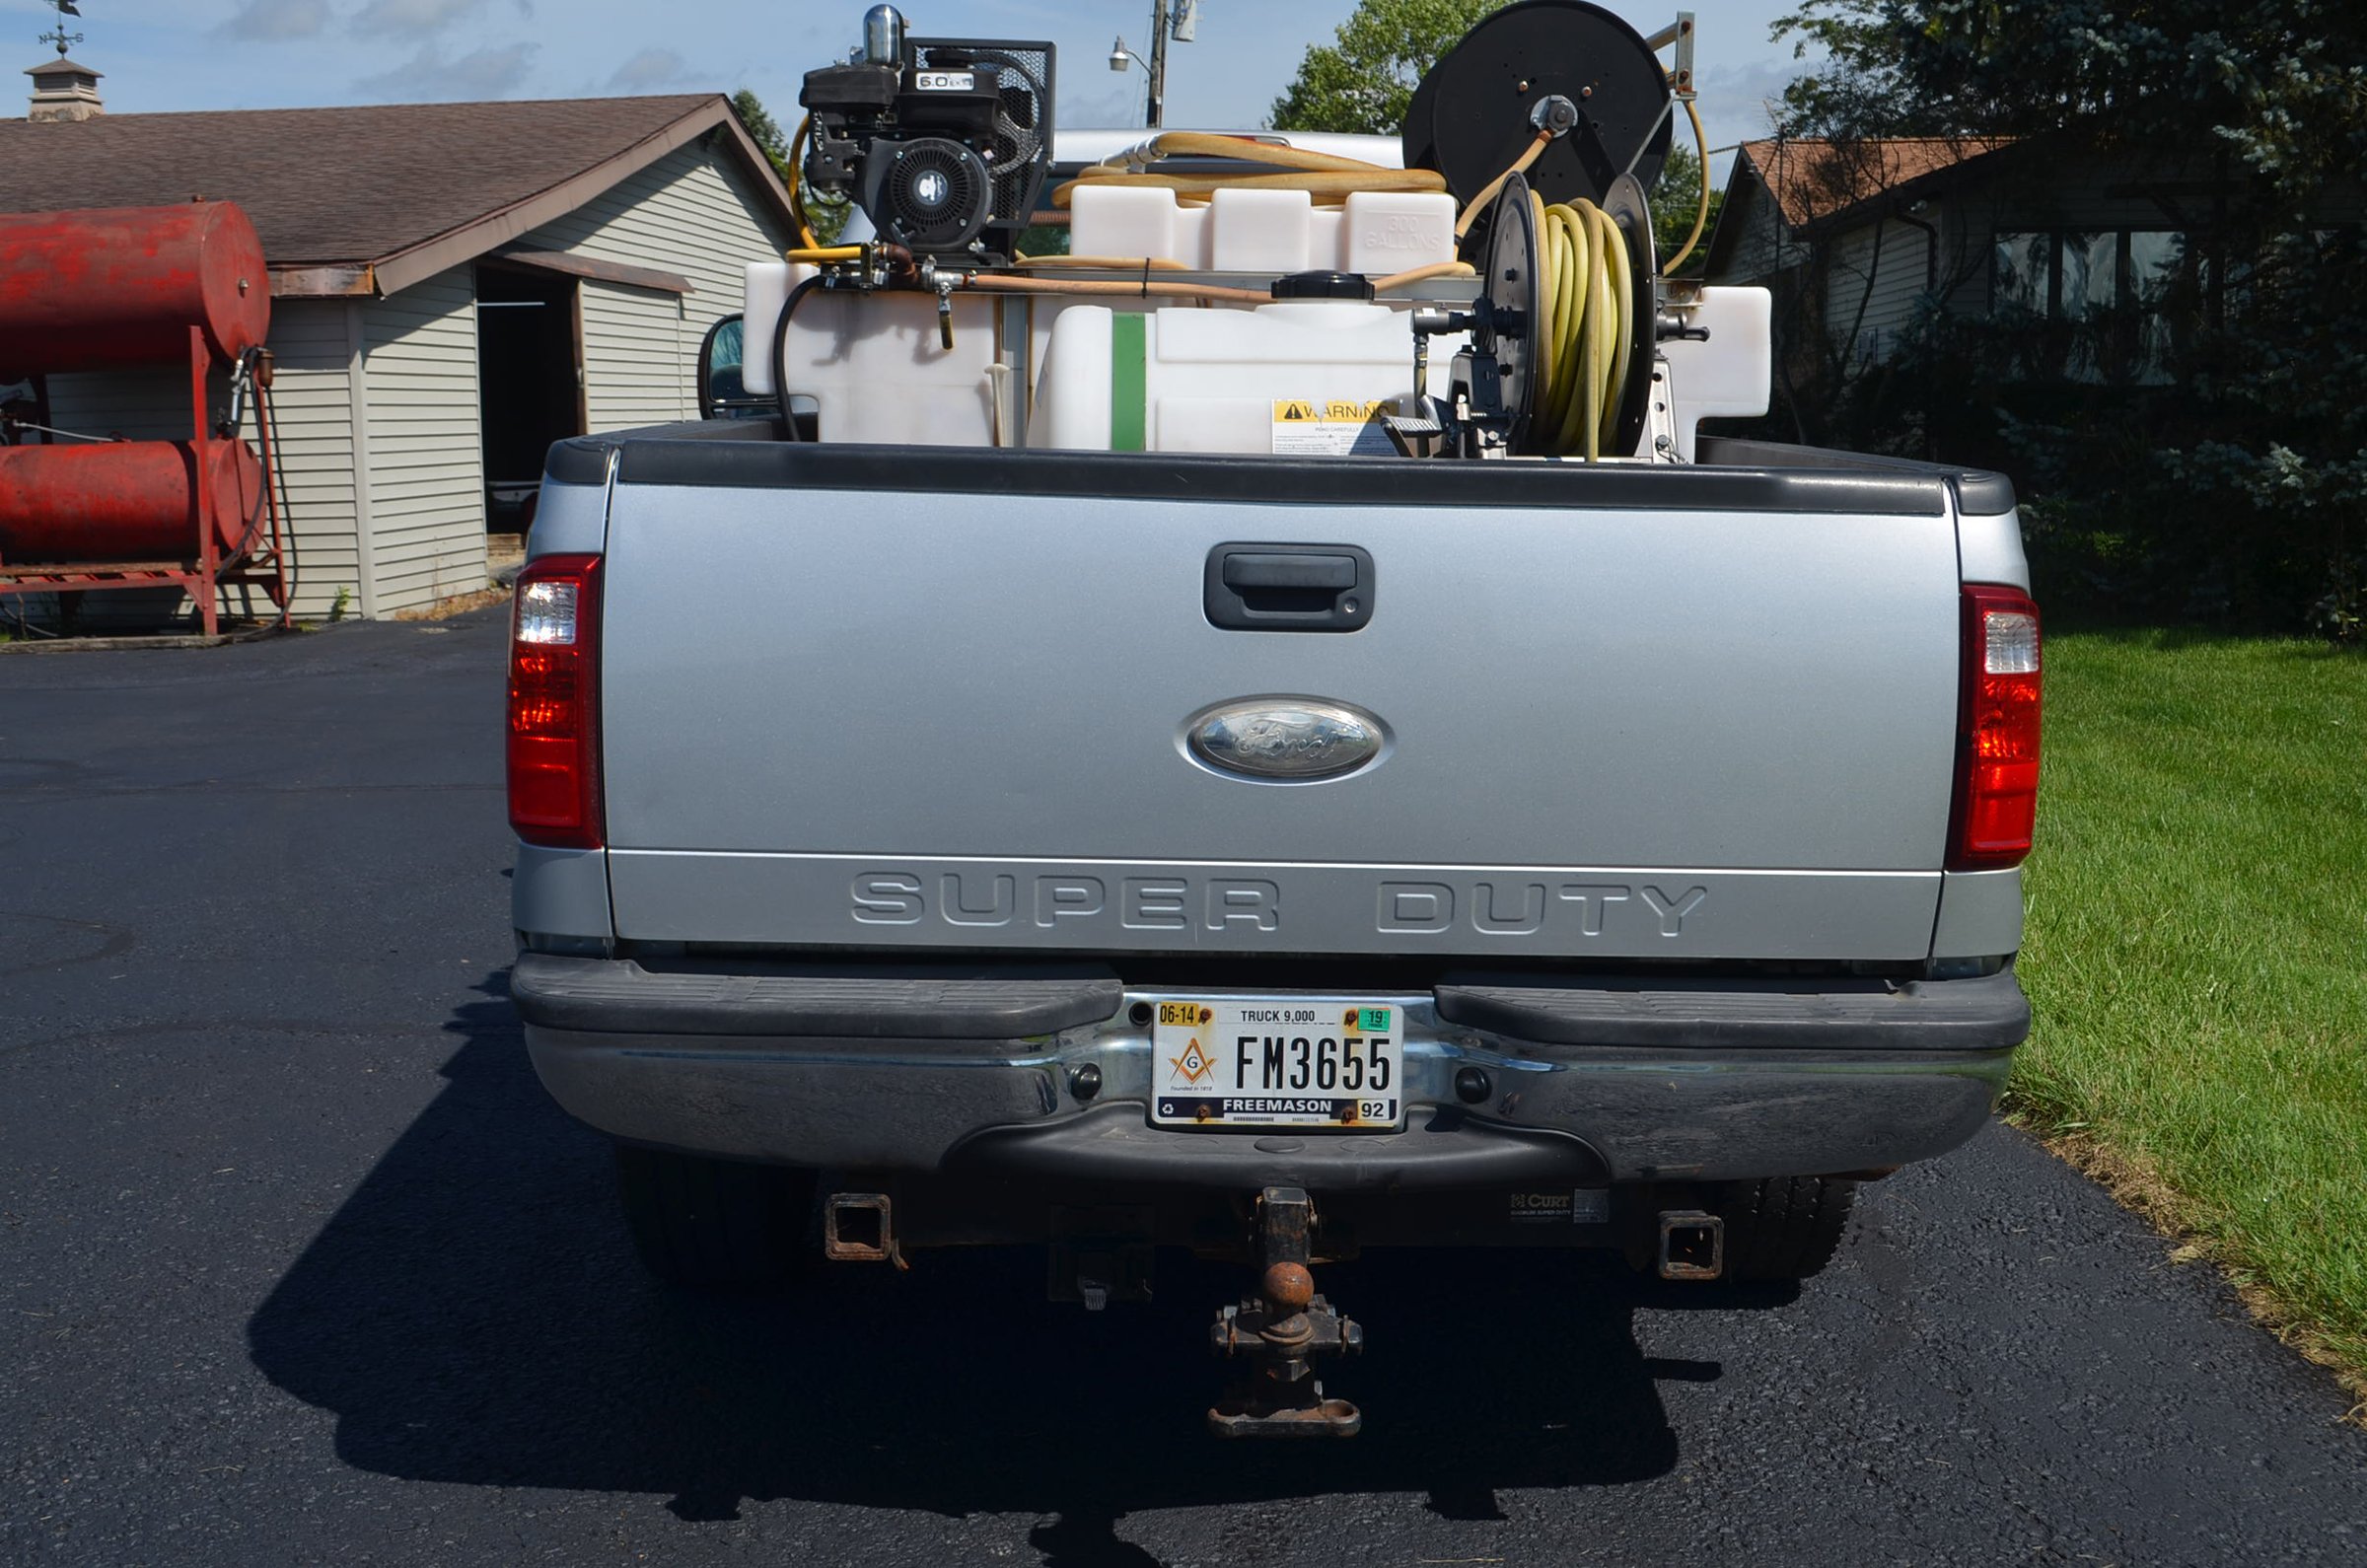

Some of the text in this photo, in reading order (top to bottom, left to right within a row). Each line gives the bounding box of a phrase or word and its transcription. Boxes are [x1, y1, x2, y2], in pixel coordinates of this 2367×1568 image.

[919, 76, 948, 88] 6.0
[1365, 231, 1441, 251] GALLONS
[1232, 717, 1335, 758] Ford
[850, 871, 1708, 937] SUPER DUTY
[1160, 1005, 1194, 1024] 06-14
[1241, 1010, 1280, 1022] TRUCK
[1368, 1010, 1383, 1024] 19
[1186, 1056, 1198, 1069] G
[1236, 1035, 1391, 1092] FM3655
[1223, 1099, 1332, 1113] FREEMASON
[1360, 1103, 1385, 1118] 92
[1527, 1193, 1570, 1208] CURT
